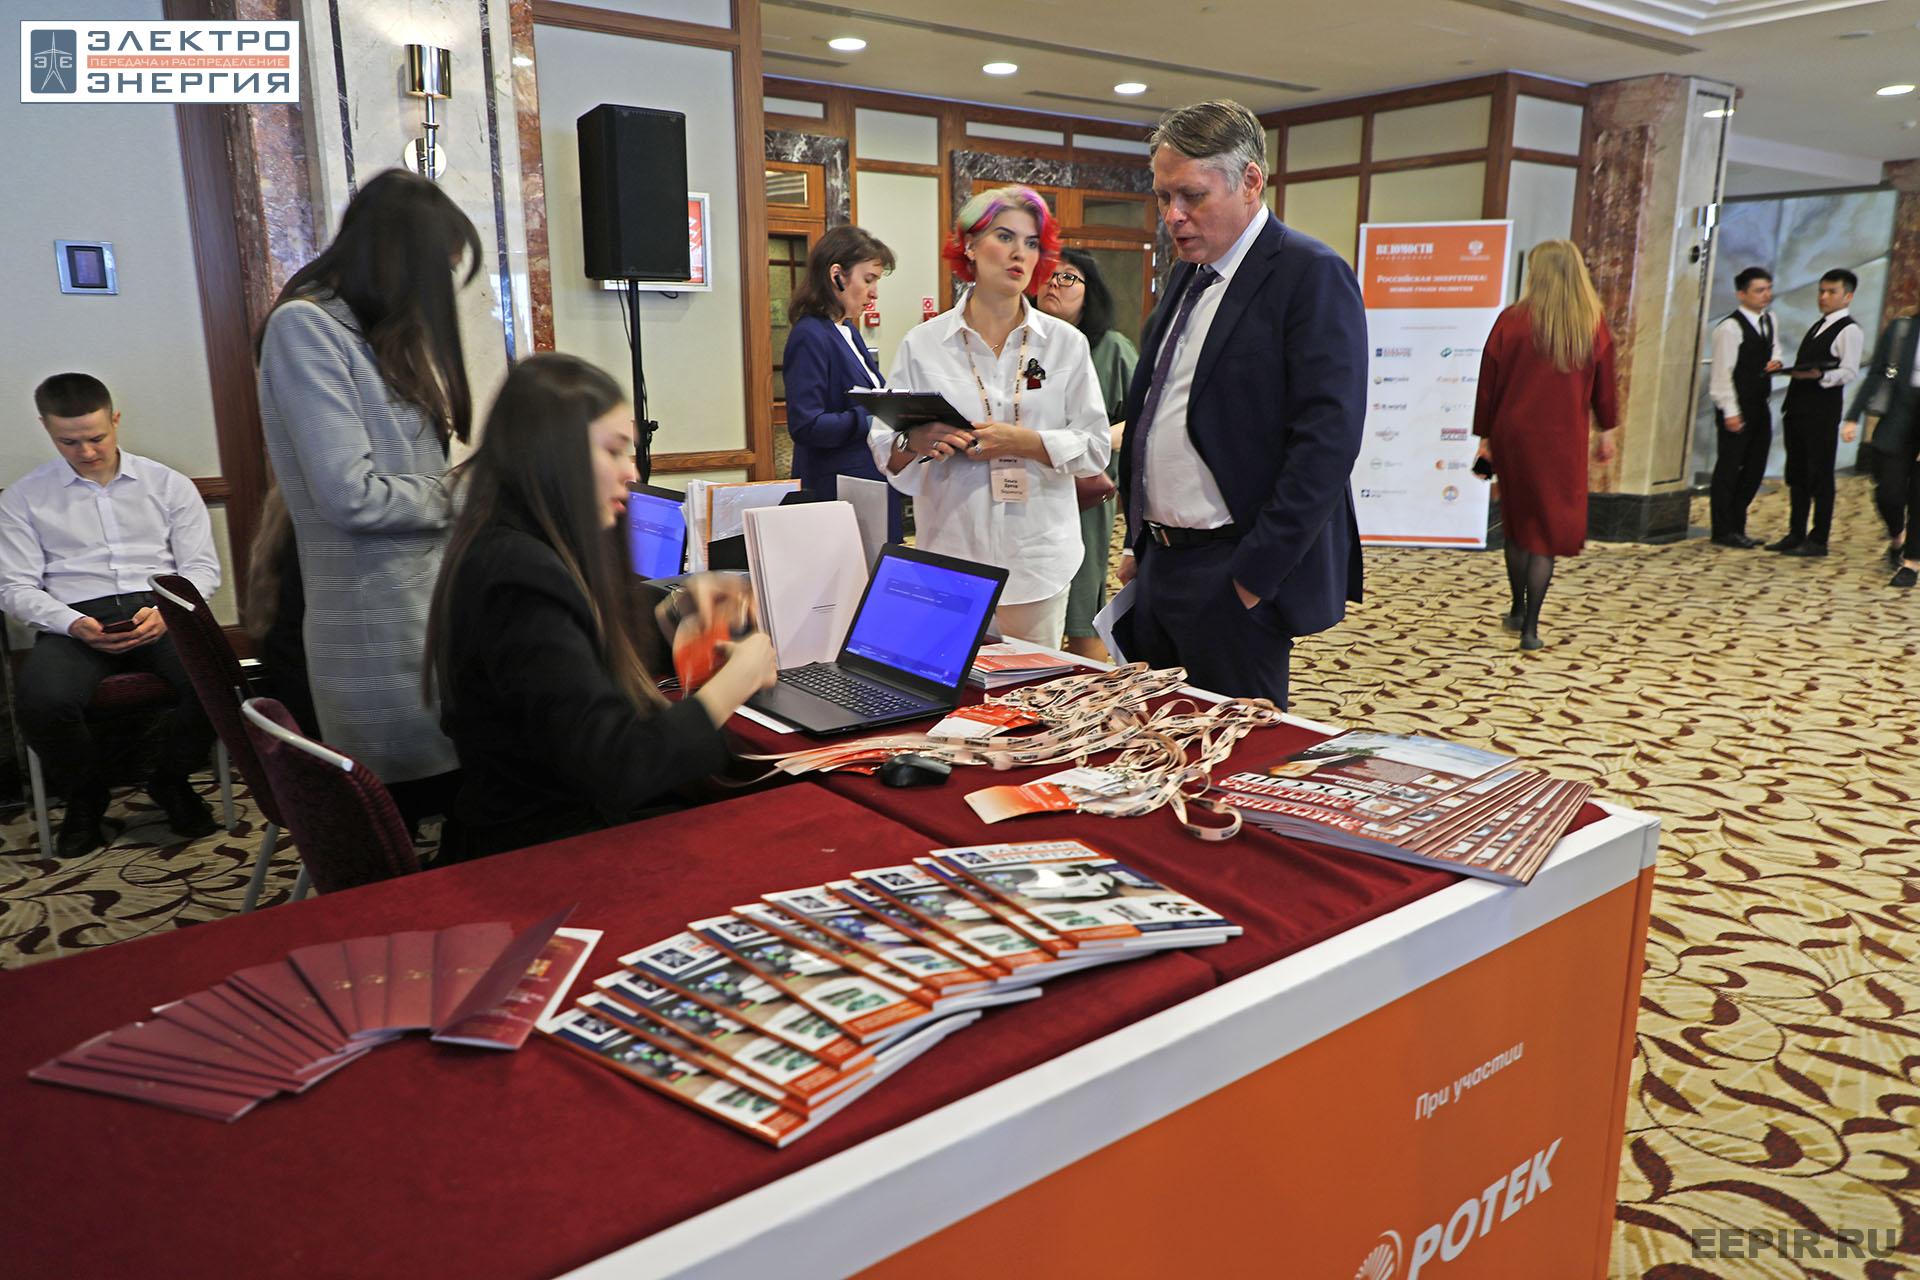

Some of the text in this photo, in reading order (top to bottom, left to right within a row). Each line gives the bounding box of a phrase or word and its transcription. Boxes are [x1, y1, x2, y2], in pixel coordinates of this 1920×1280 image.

[1414, 1041, 1525, 1120] При участии
[1407, 1136, 1563, 1280] РОТЕК
